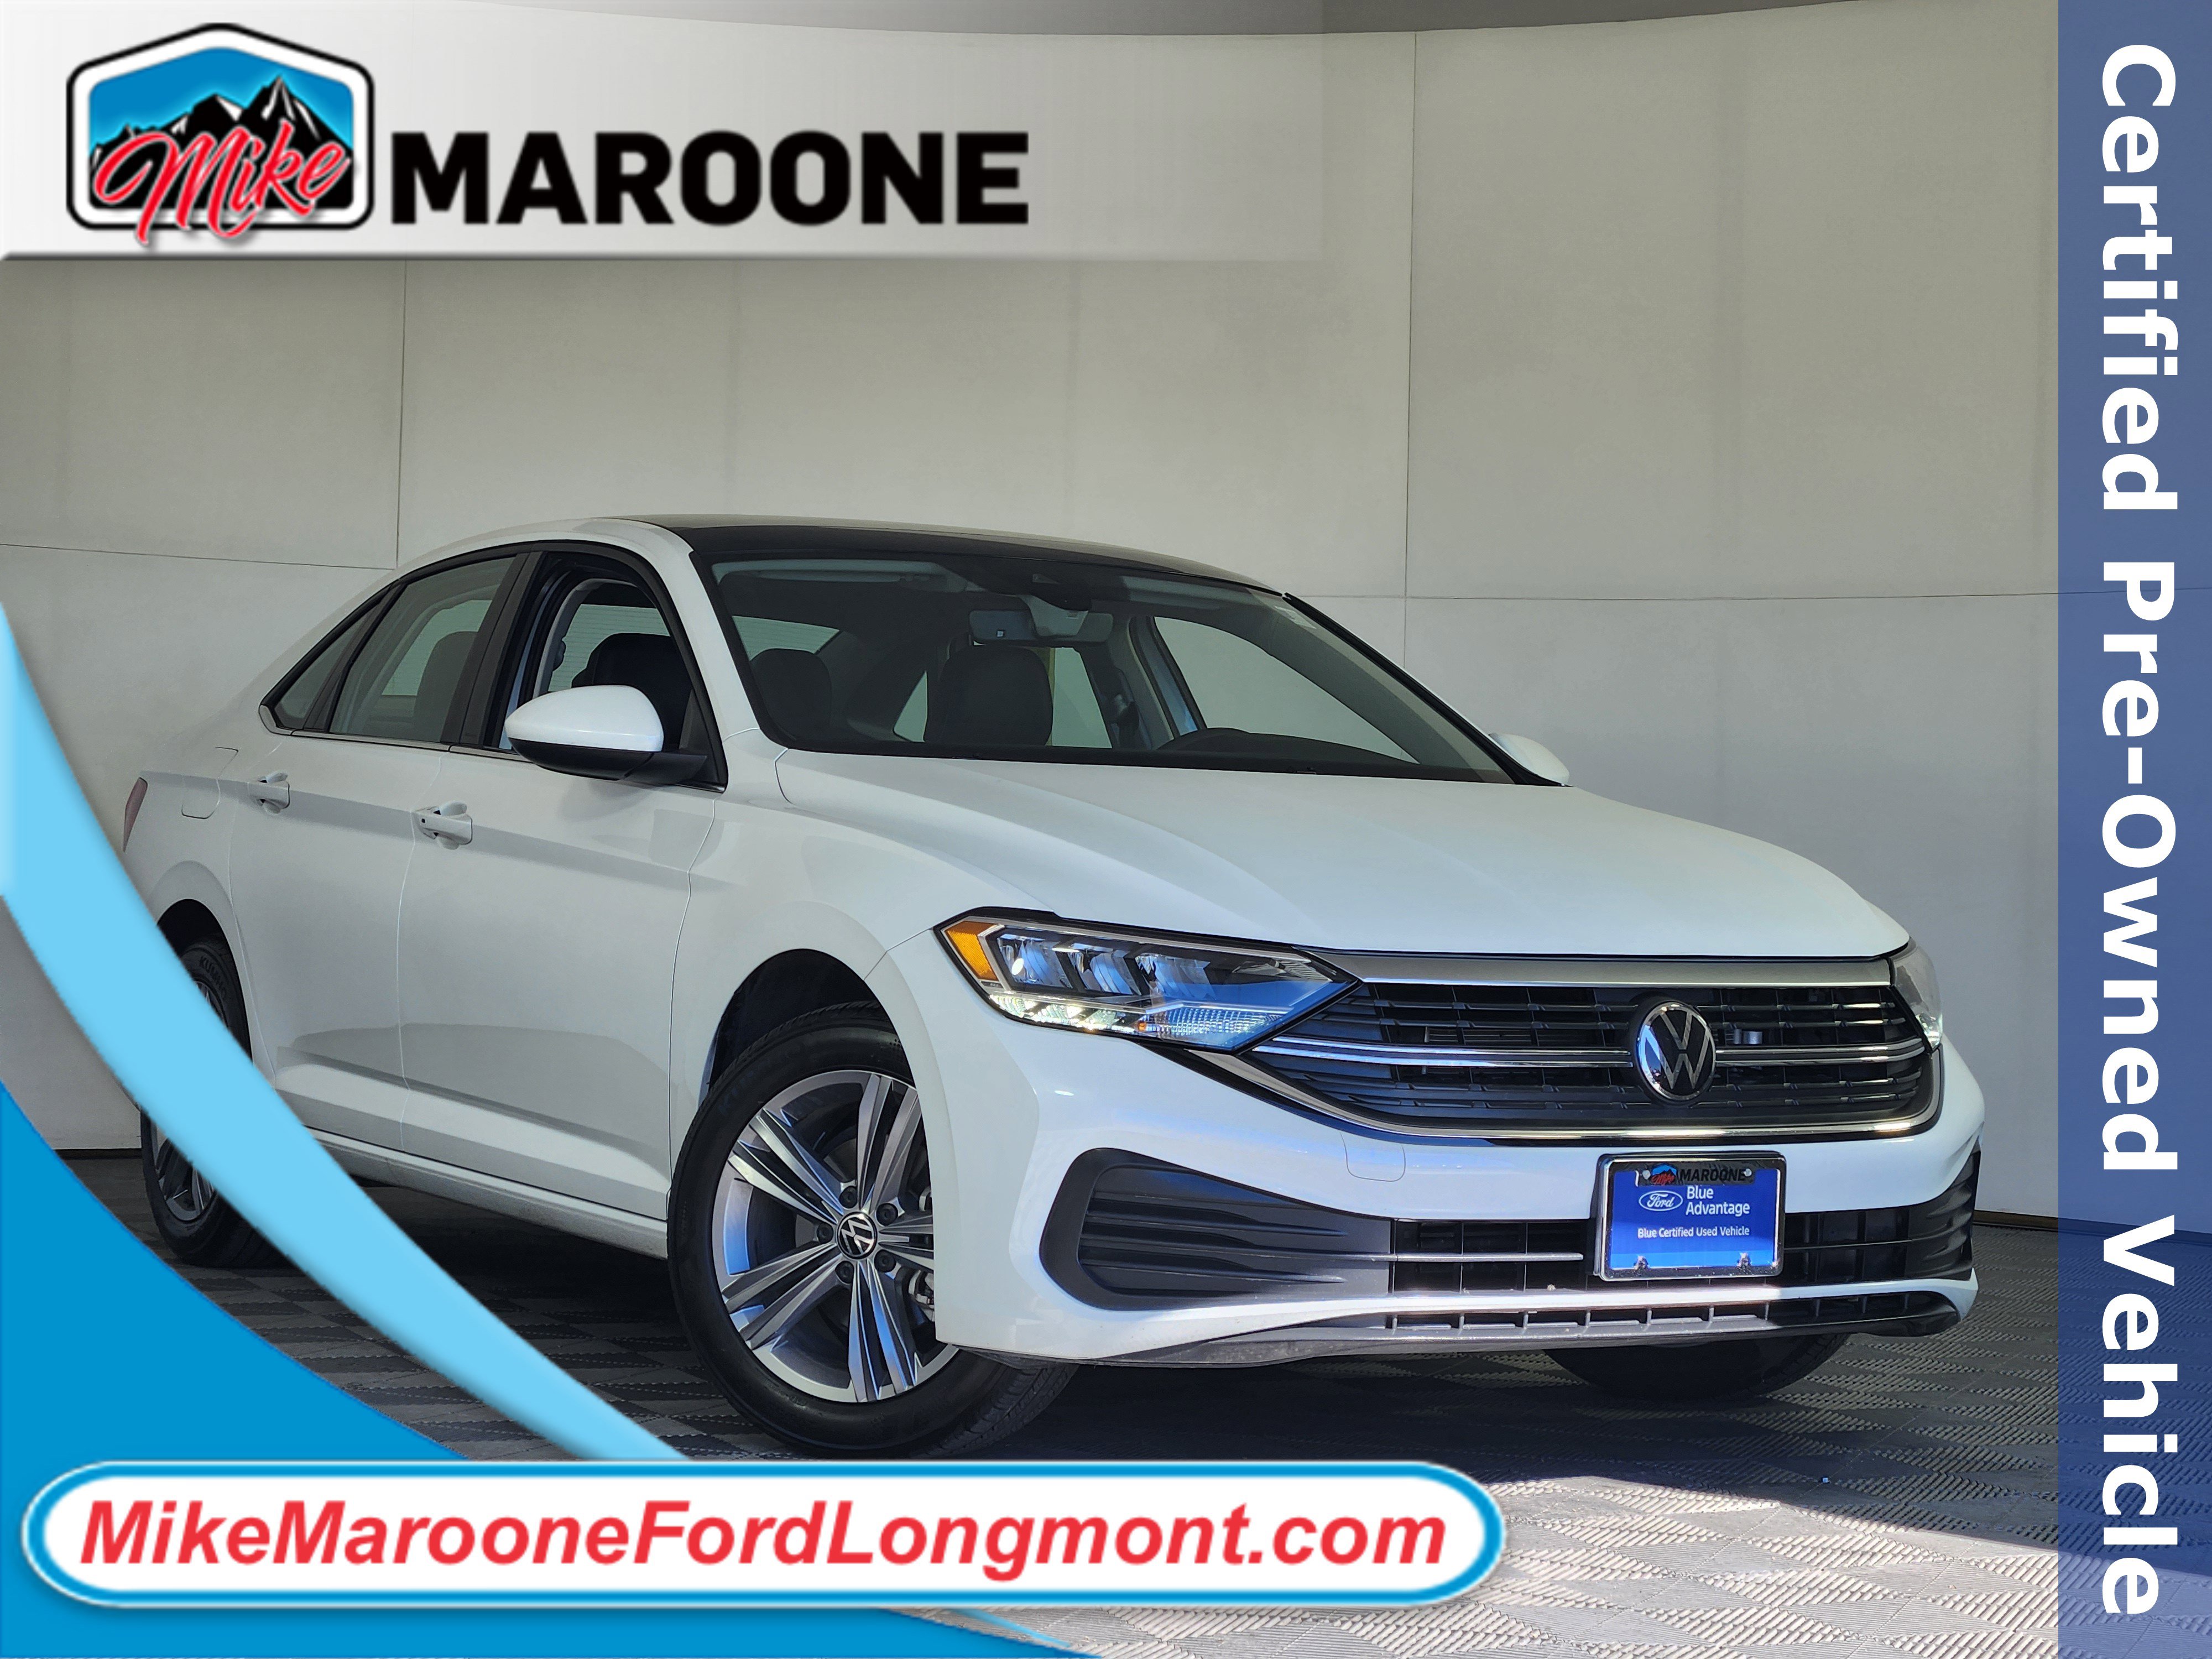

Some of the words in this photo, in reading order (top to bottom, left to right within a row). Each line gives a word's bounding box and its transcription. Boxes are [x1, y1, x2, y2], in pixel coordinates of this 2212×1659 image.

[1680, 1168, 1745, 1181] MAROONE
[1687, 1185, 1714, 1199] Blue
[1646, 1193, 1675, 1208] Ford
[1686, 1201, 1750, 1217] Advantage
[1637, 1228, 1657, 1238] Blue
[1658, 1227, 1694, 1238] Certified
[1696, 1227, 1718, 1237] Used
[1720, 1225, 1750, 1236] Vehicle
